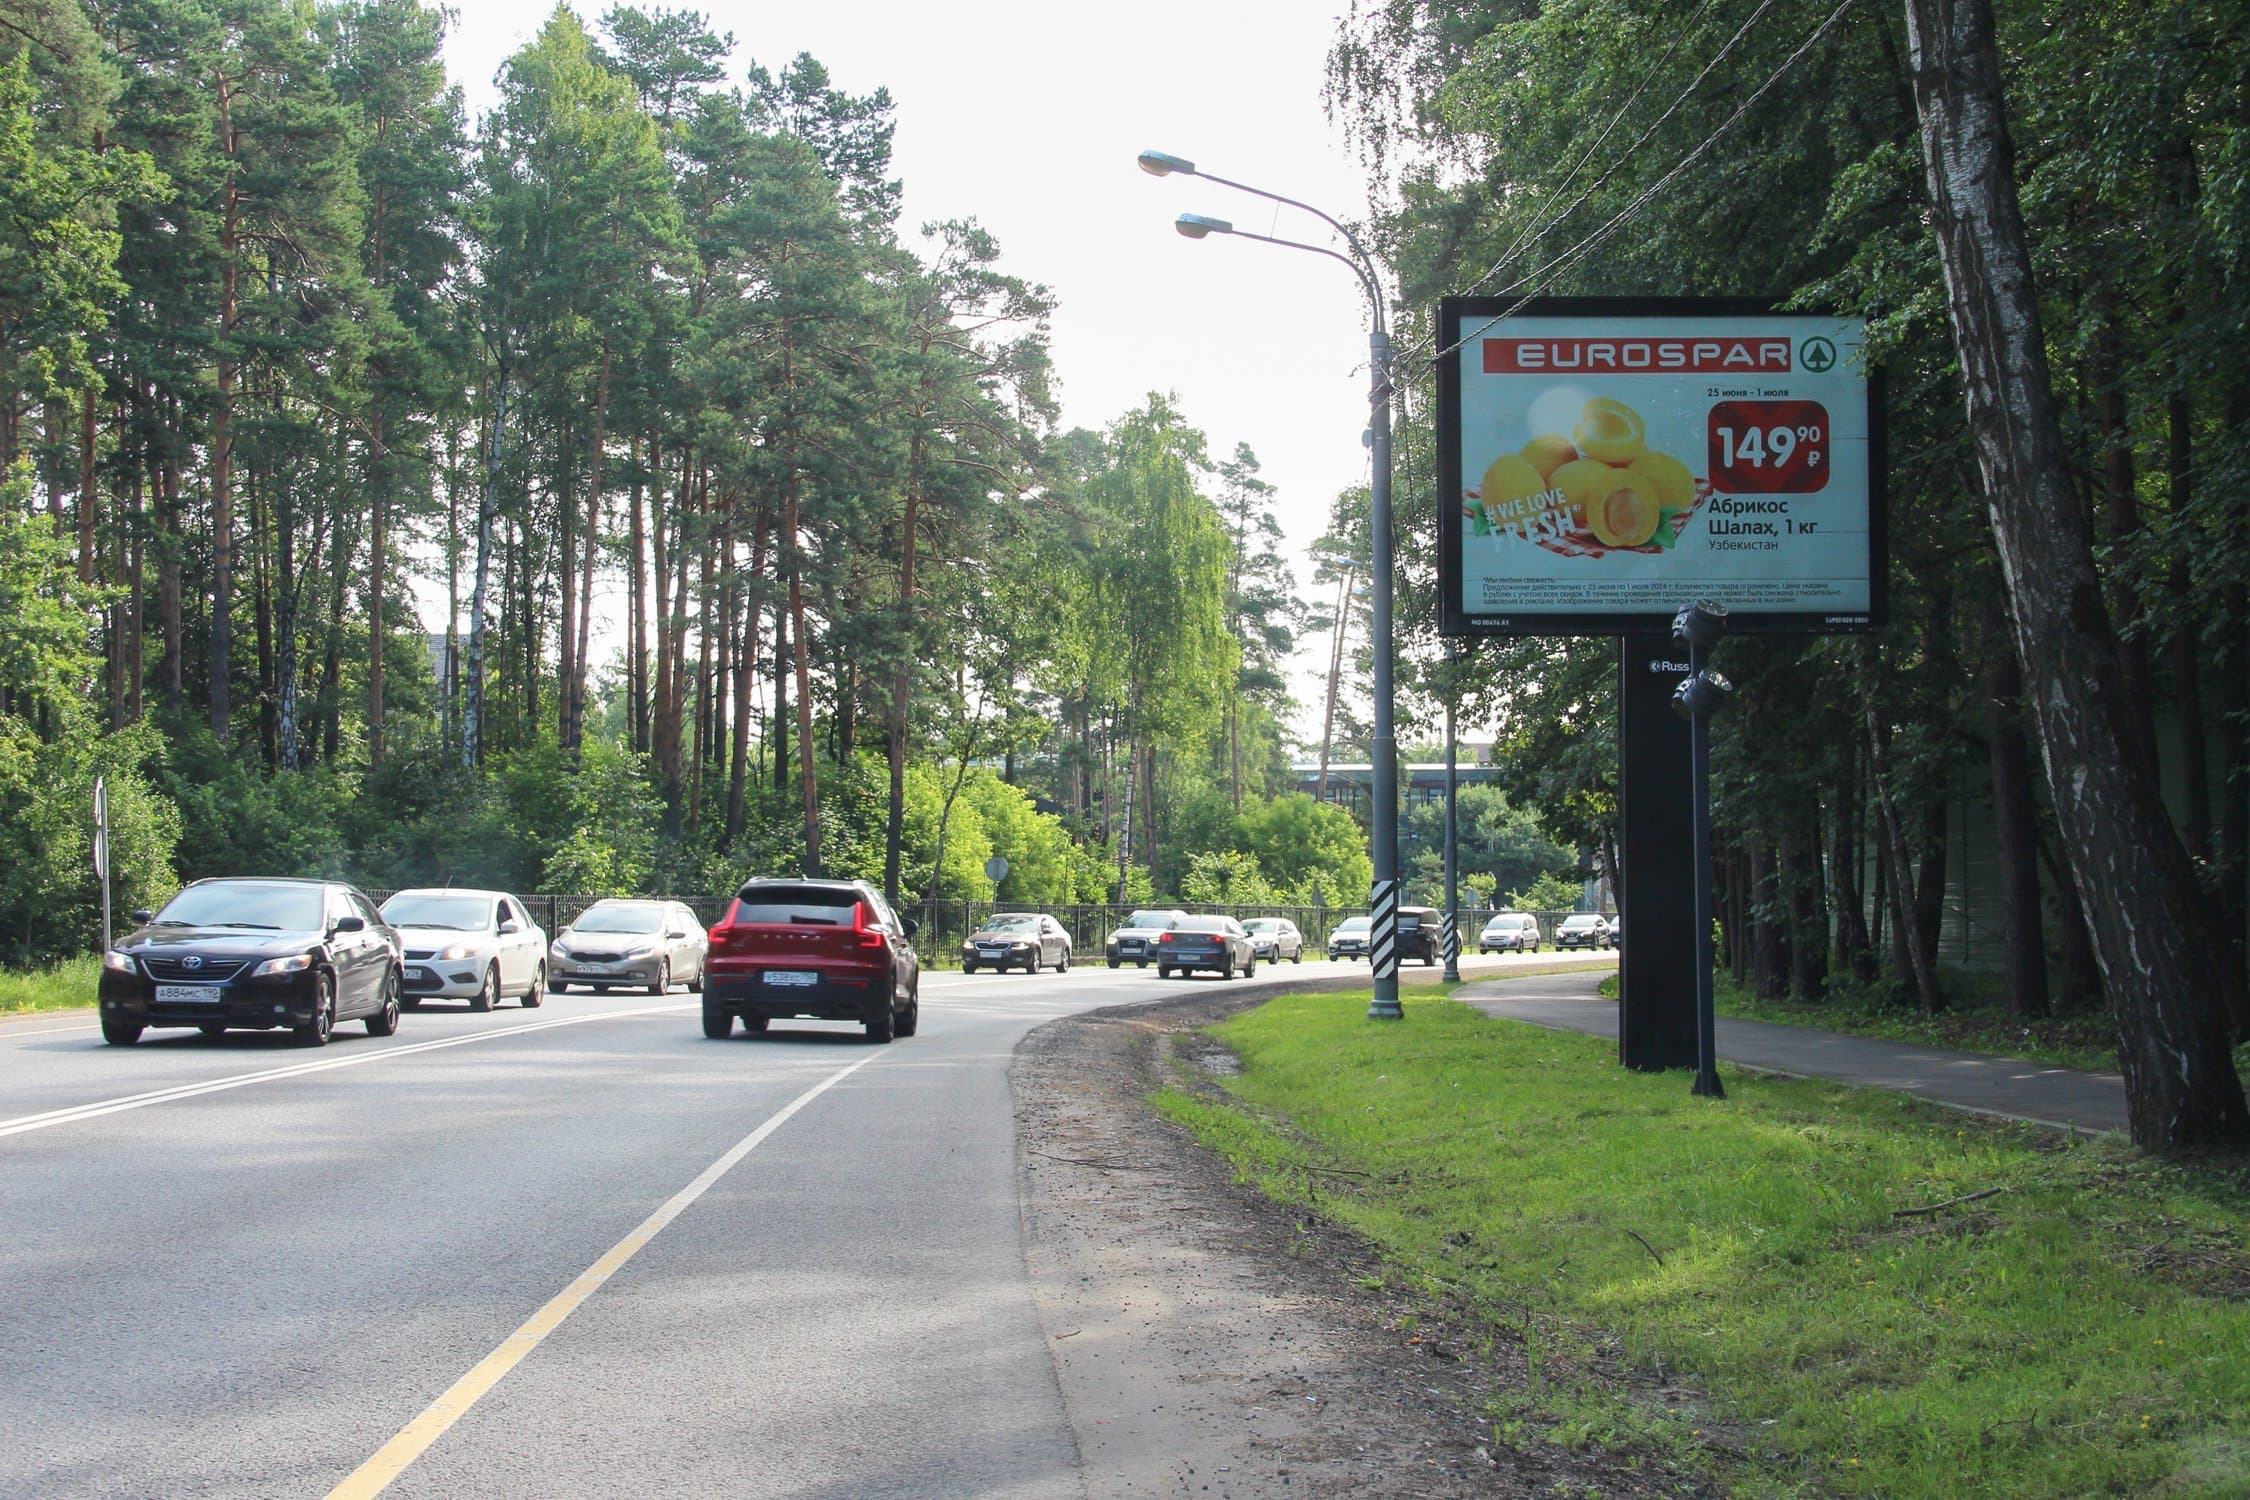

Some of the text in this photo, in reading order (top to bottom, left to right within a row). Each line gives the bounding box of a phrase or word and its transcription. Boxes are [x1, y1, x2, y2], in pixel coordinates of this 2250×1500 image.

[1517, 343, 1788, 368] EUROSPAR
[1707, 388, 1719, 397] 25
[1722, 389, 1747, 397] июня
[1756, 388, 1761, 397] 1
[1764, 389, 1789, 397] июля
[1526, 487, 1568, 512] LOVE
[1708, 498, 1789, 518] Абрикос
[1708, 519, 1819, 537] Шалах, 1 кг
[1708, 539, 1778, 551] Узбекистан
[1661, 660, 1690, 672] Russ
